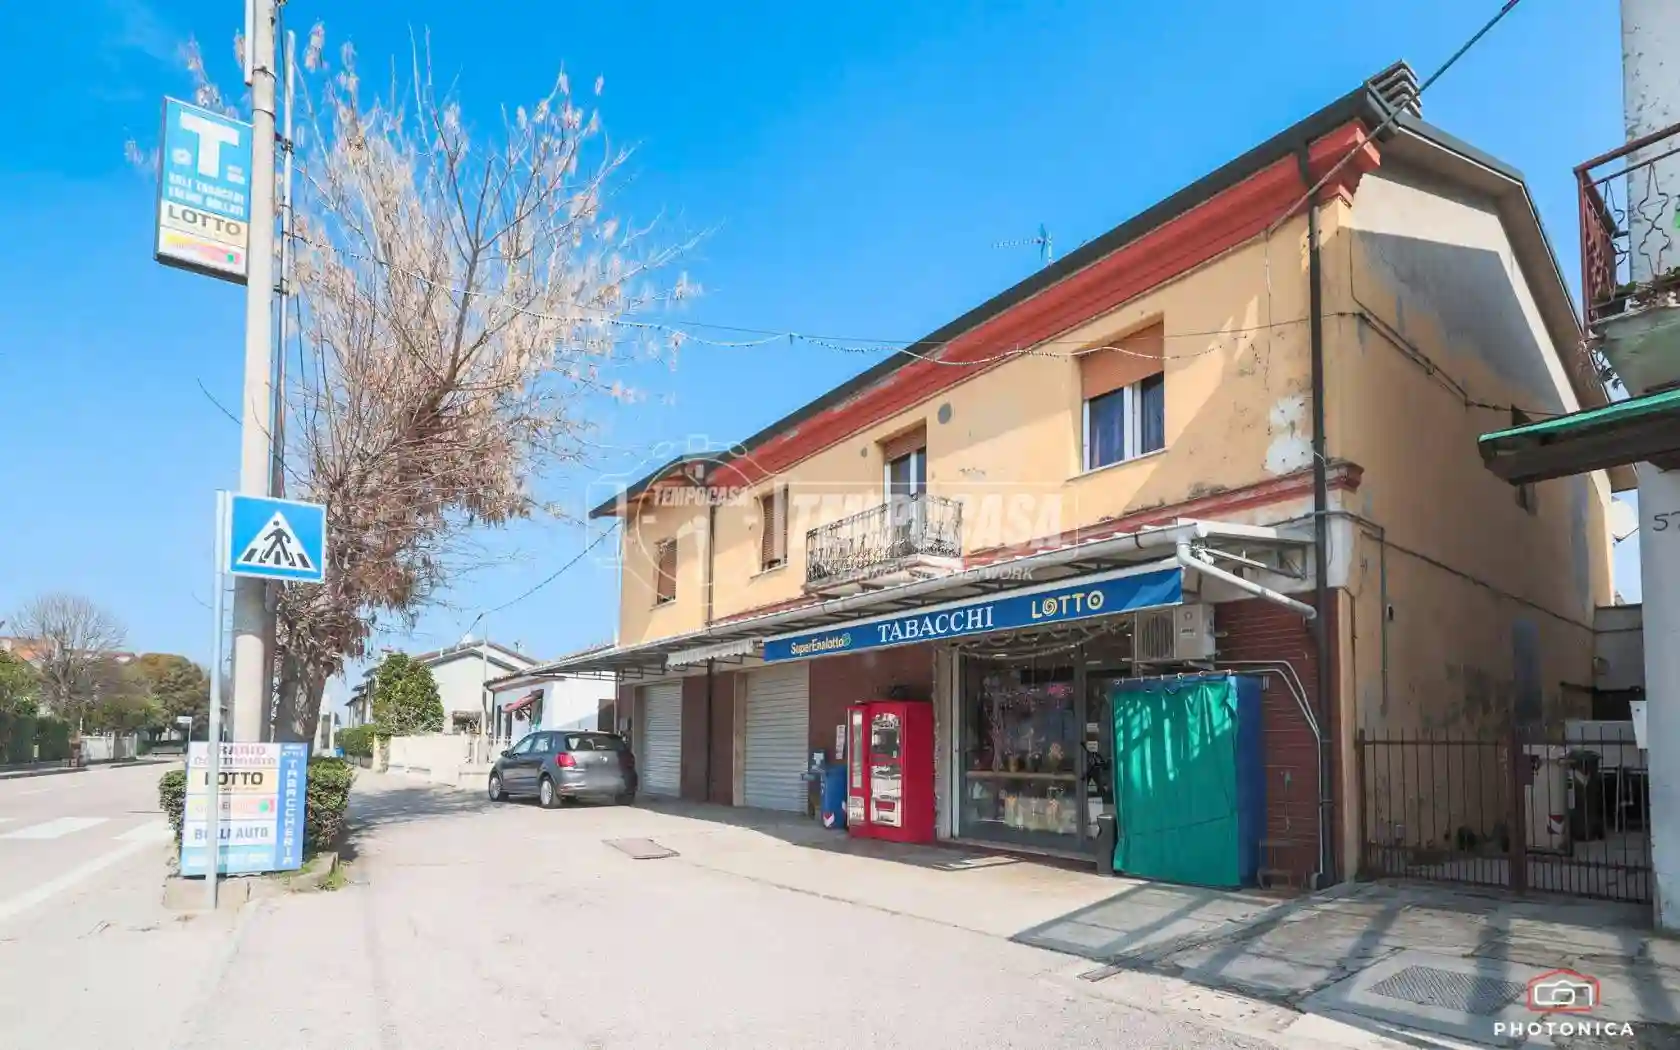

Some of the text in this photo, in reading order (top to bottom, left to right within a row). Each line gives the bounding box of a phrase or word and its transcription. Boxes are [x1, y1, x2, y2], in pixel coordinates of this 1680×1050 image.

[180, 109, 240, 179] T
[168, 204, 241, 236] LOTTO
[1031, 590, 1104, 619] LOTTO
[878, 606, 994, 643] TABACCHI
[236, 826, 268, 840] AUTO
